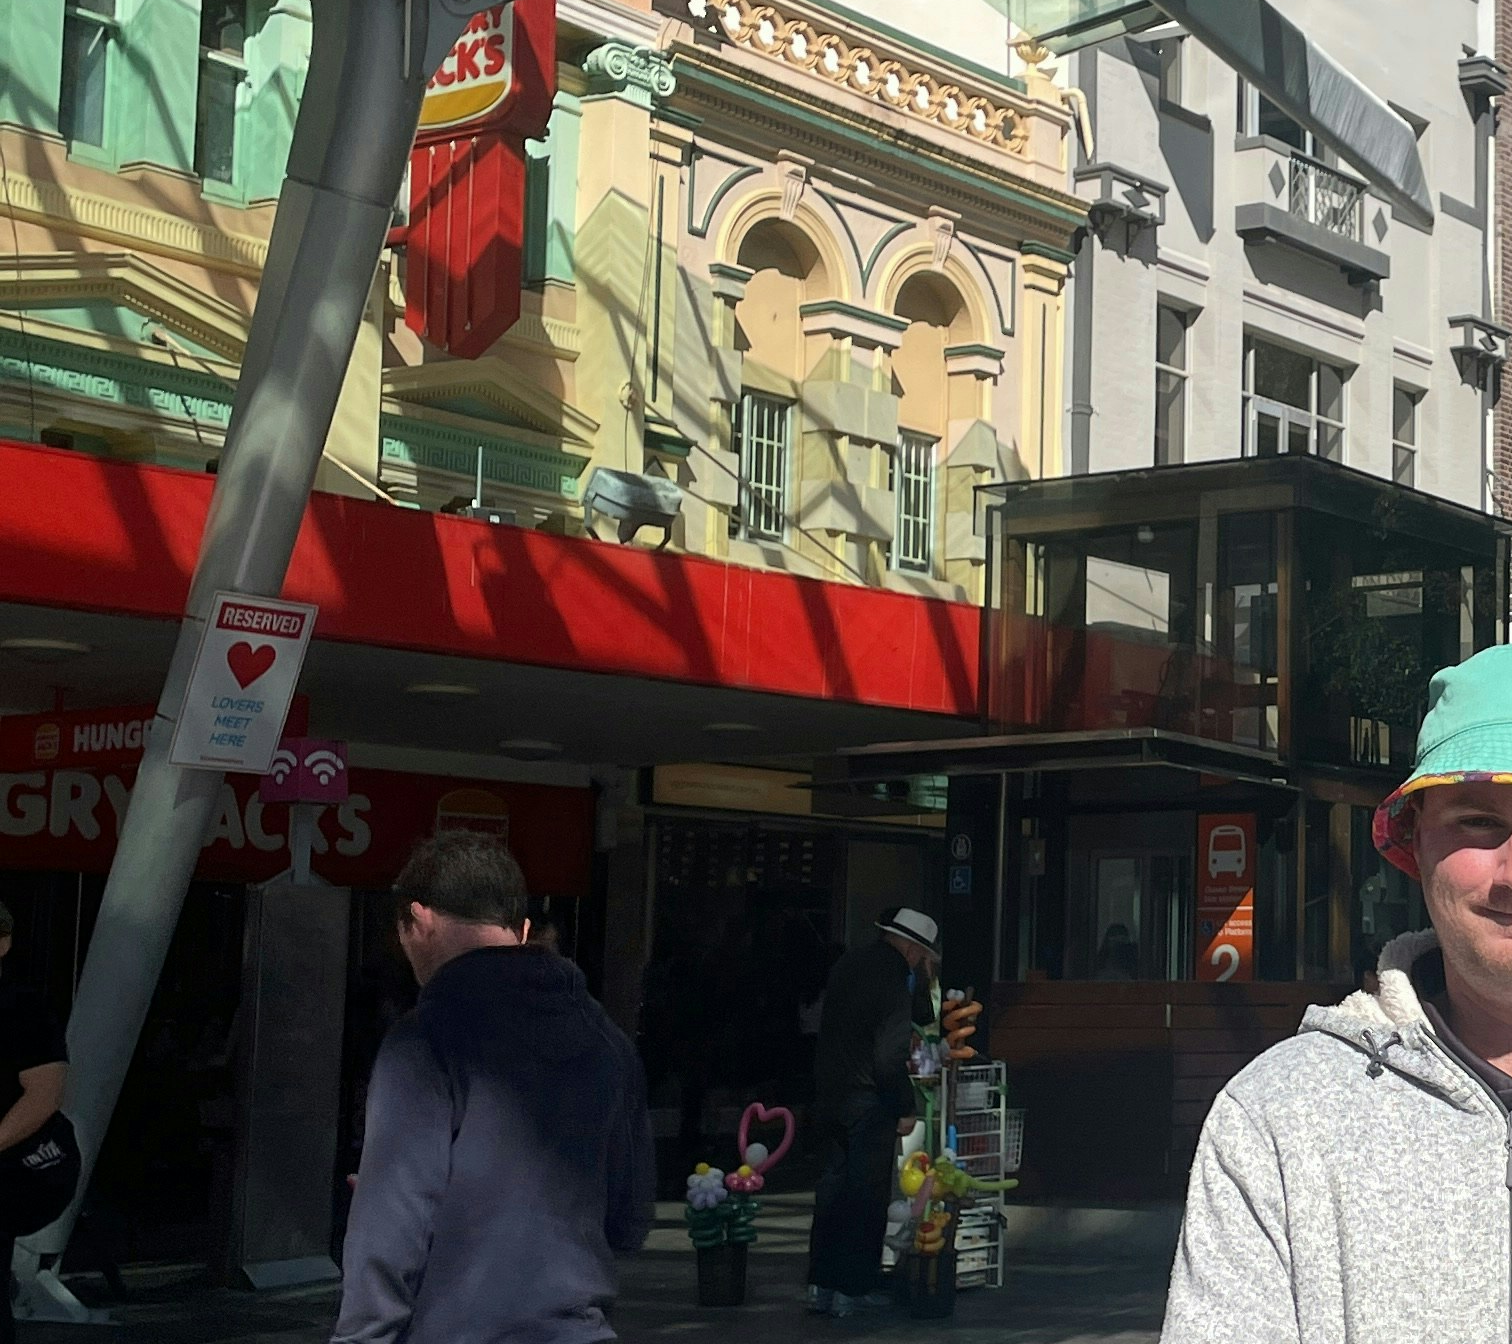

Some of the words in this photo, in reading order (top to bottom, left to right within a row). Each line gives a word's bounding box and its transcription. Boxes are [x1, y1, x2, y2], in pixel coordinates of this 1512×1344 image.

[222, 606, 301, 634] RESERVED
[211, 696, 264, 714] LOVERS
[214, 716, 252, 730] MEET
[209, 733, 247, 748] HERE
